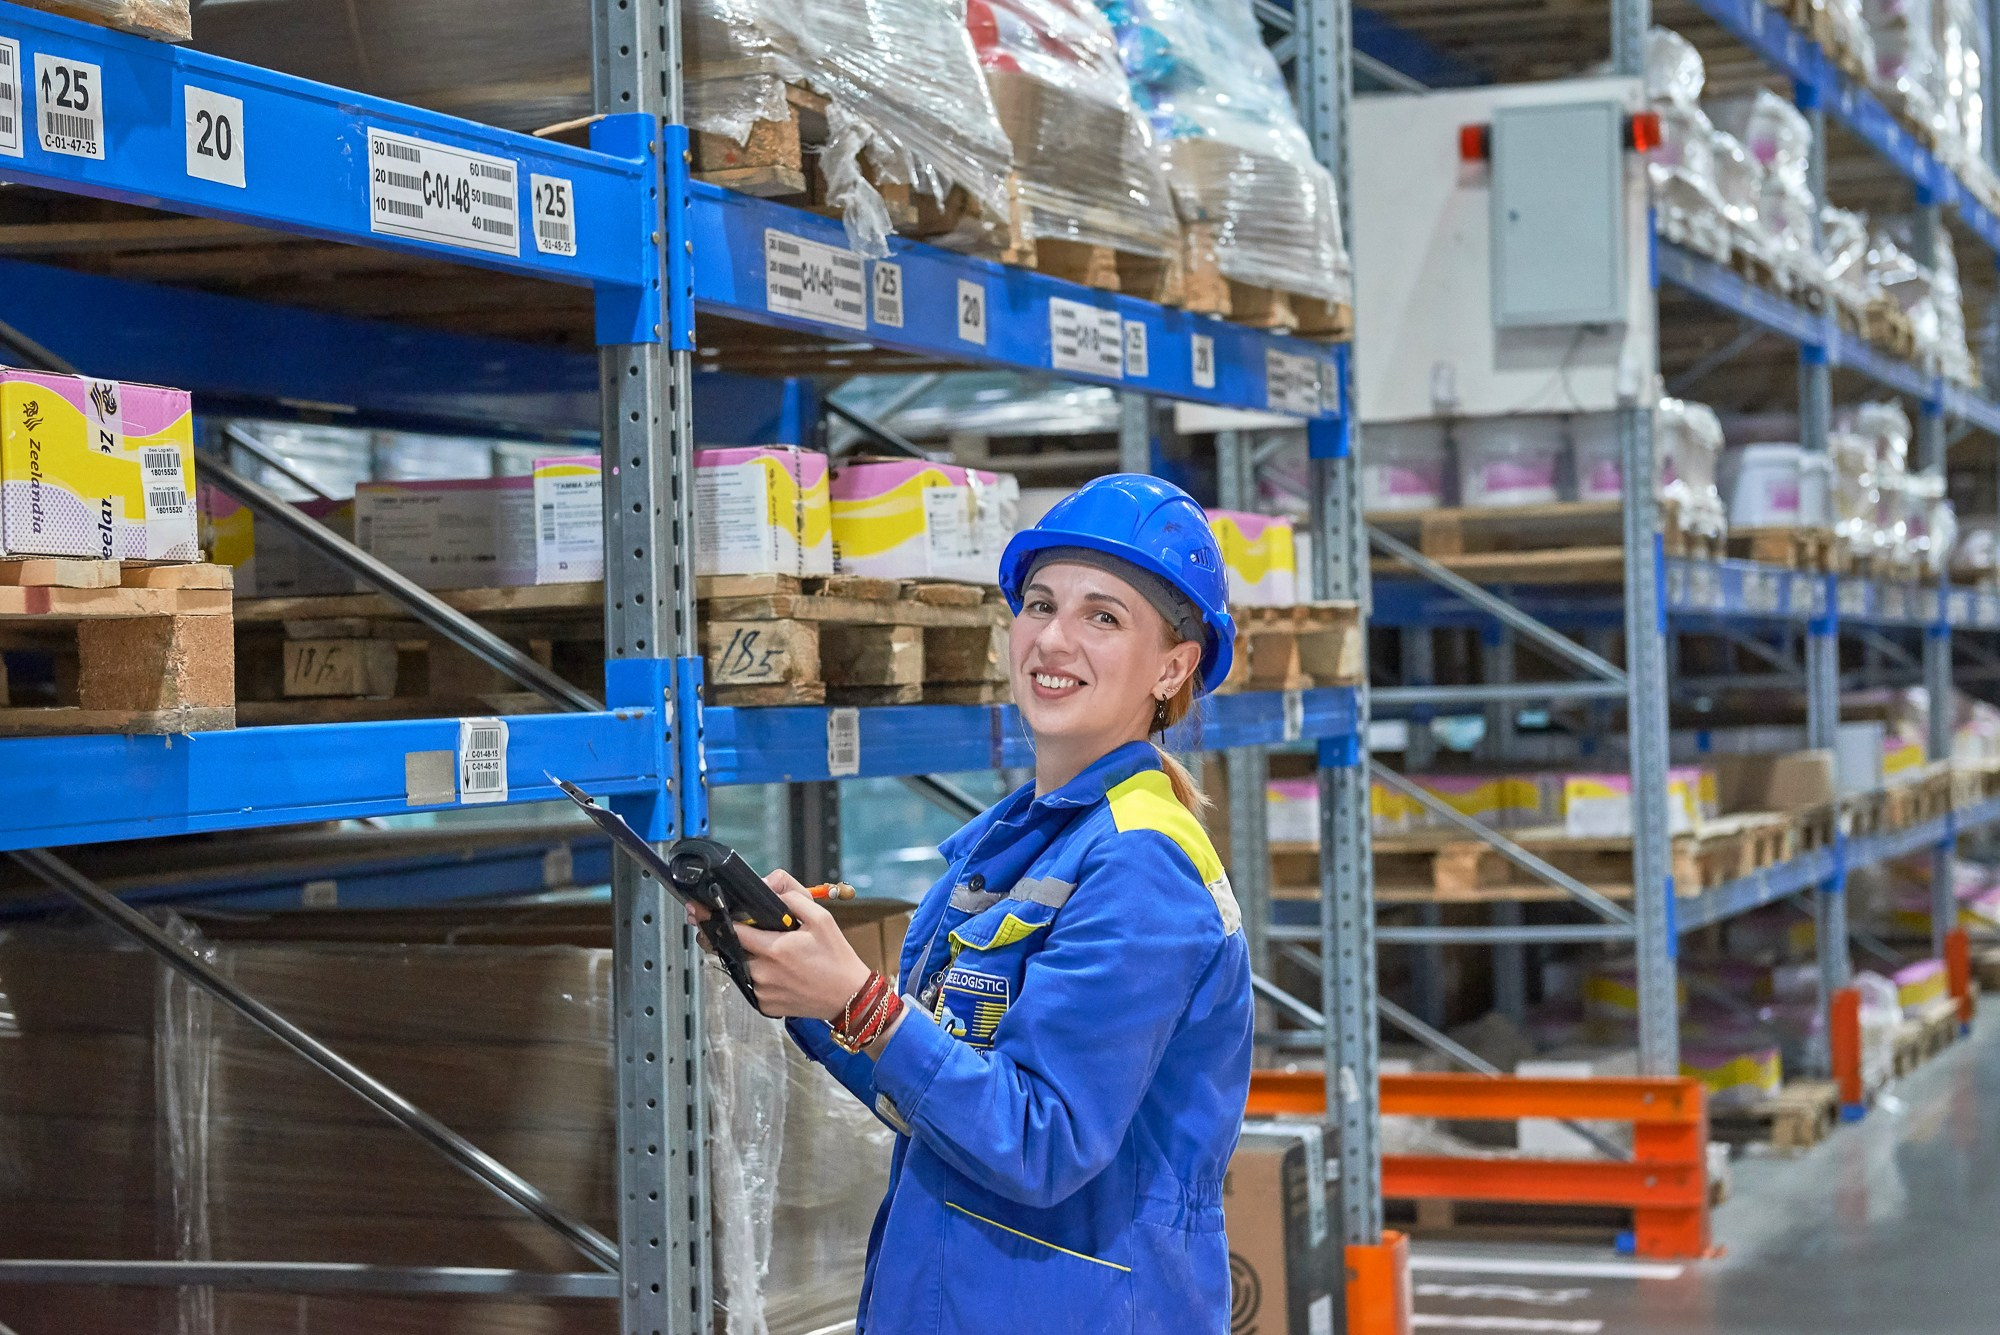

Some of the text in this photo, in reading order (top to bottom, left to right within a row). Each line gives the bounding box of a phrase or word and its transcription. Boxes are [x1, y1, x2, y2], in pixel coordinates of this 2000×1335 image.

[55, 66, 90, 111] 25
[196, 109, 232, 161] 20
[45, 134, 97, 155] C-01-47-25
[374, 141, 385, 155] 30
[375, 169, 386, 183] 20
[469, 162, 480, 177] 60
[422, 170, 471, 214] C-01-48
[471, 189, 481, 203] 50
[375, 197, 386, 212] 10
[544, 183, 566, 218] 25
[472, 217, 482, 230] 40
[881, 267, 897, 296] 25
[963, 293, 981, 328] 20
[151, 468, 177, 476] 18015520
[29, 438, 44, 534] Zeelandia
[156, 506, 183, 514] 18015520
[716, 628, 785, 678] 185
[471, 750, 498, 758] C-01-48-15
[472, 762, 499, 770] C-01-48-10
